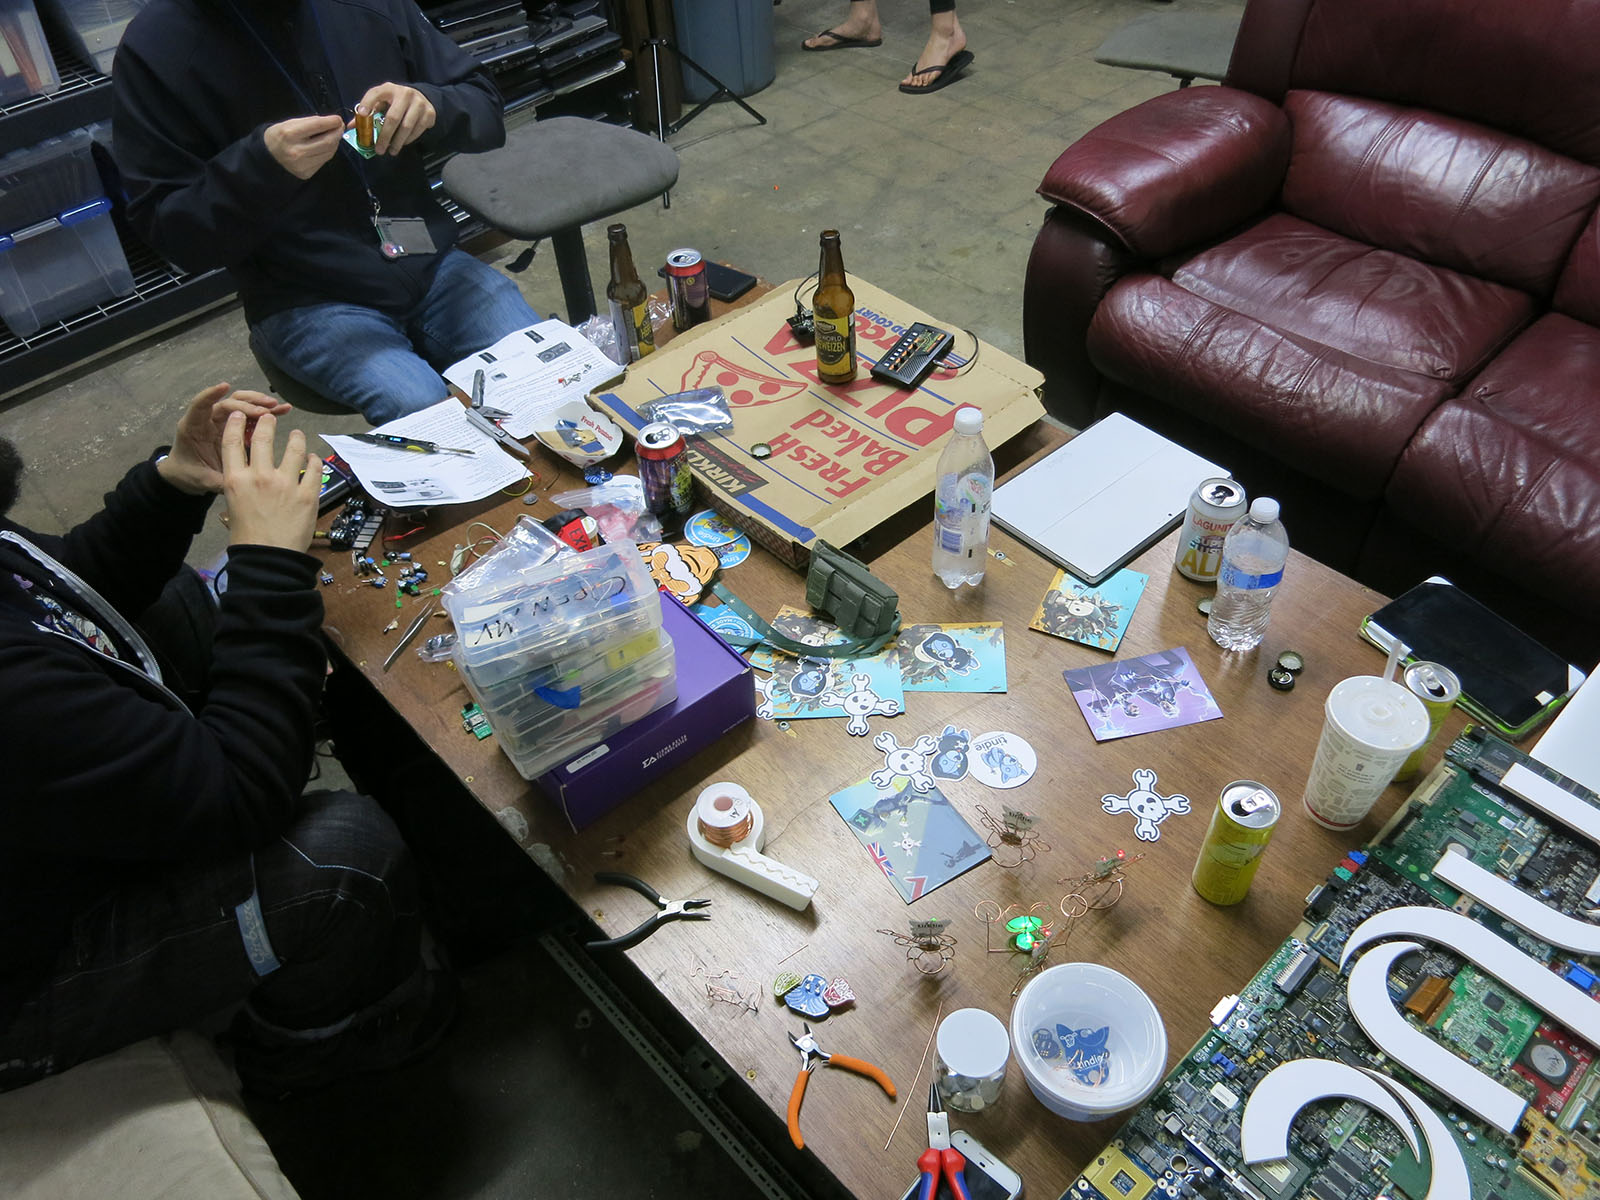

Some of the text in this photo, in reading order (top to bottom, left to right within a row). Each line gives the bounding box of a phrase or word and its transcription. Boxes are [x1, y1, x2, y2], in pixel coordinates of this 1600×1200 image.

[855, 307, 893, 328] COURT
[790, 409, 910, 476] BAKED
[687, 449, 748, 493] KIRKL
[766, 432, 872, 499] FRESH
[1192, 513, 1235, 532] LAGUNIT
[720, 554, 740, 565] tind
[1181, 548, 1222, 577] AL
[974, 735, 1008, 752] tindie
